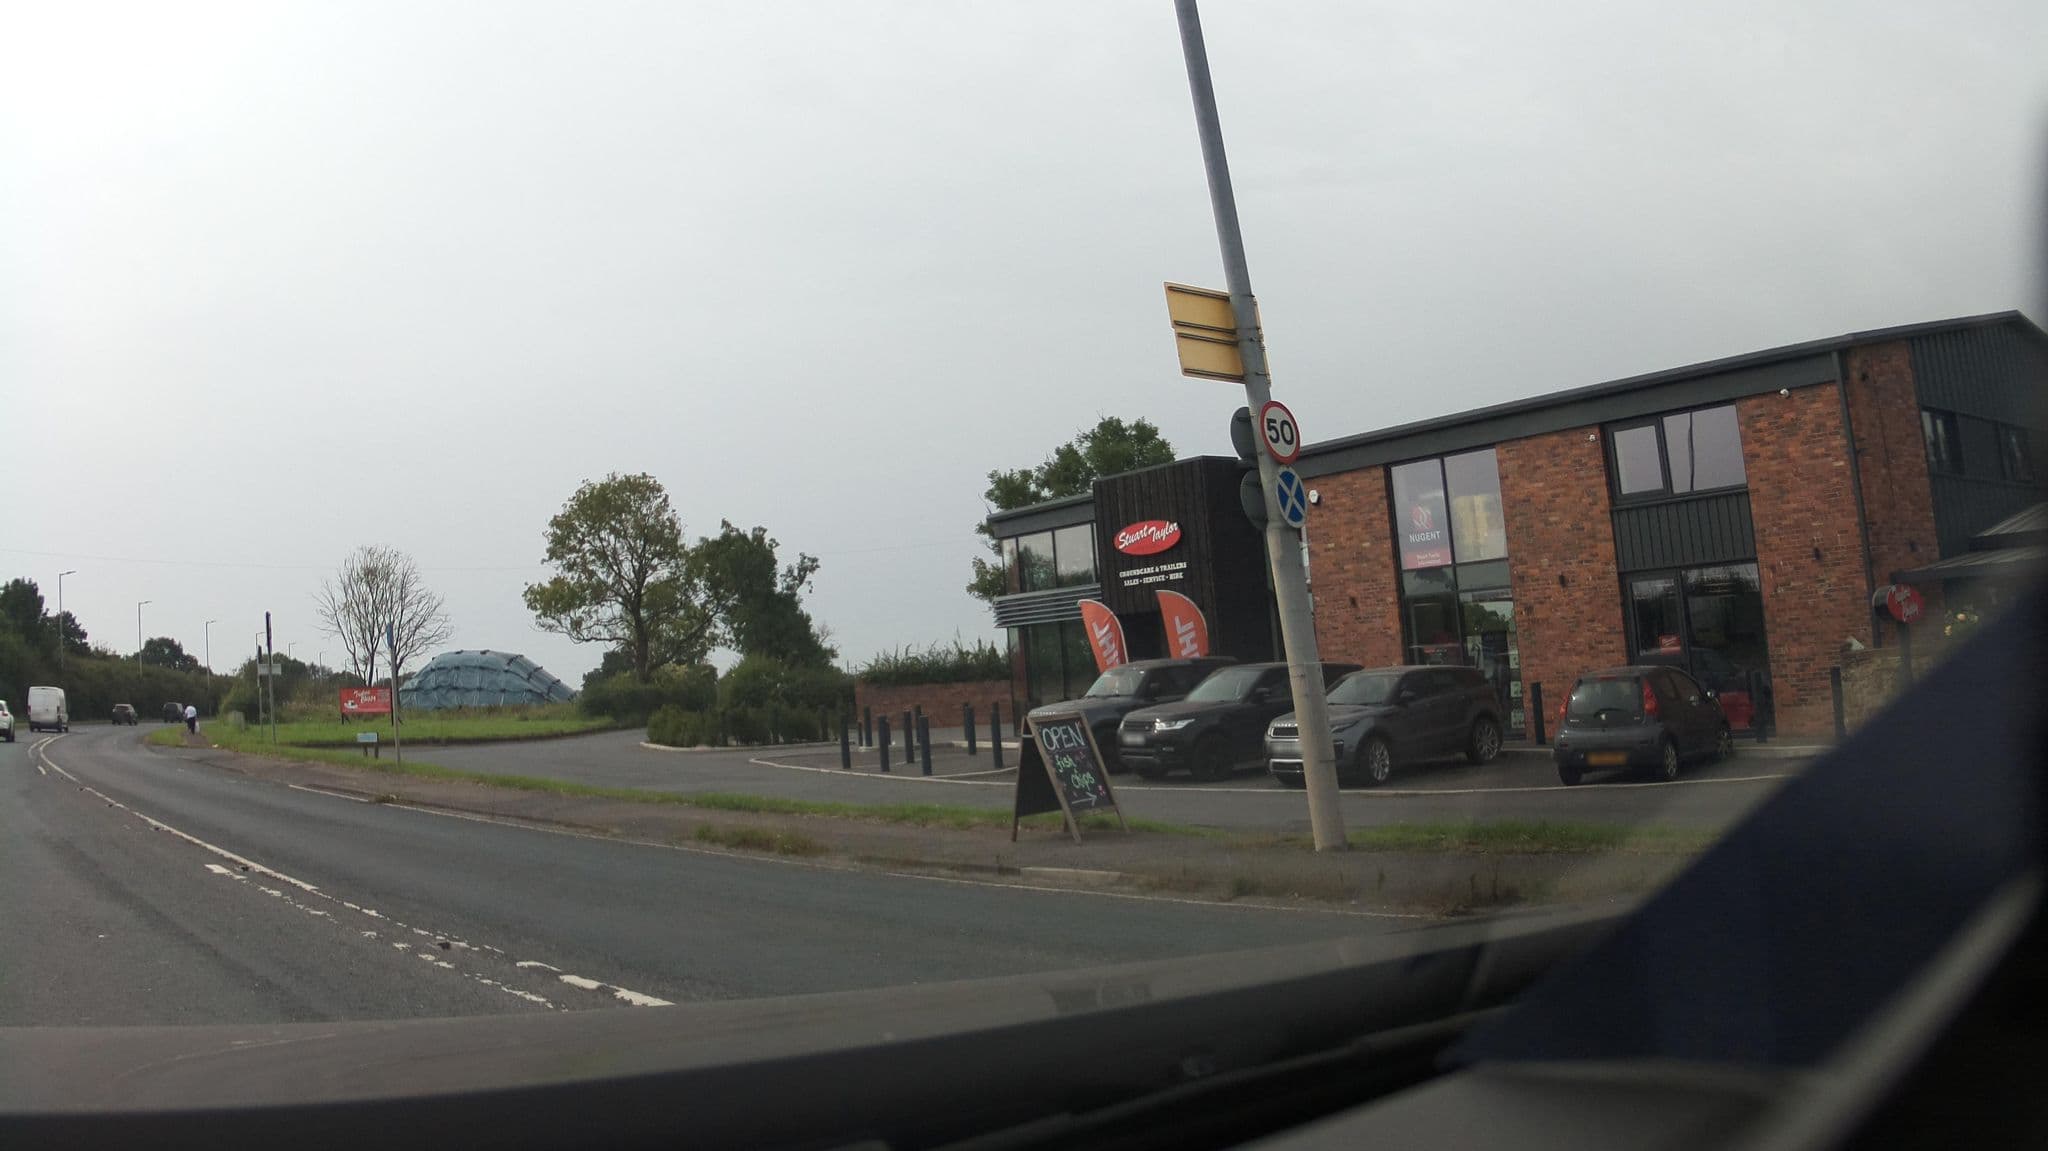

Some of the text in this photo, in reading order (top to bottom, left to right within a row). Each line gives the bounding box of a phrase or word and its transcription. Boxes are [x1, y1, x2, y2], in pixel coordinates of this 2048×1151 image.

[1266, 418, 1294, 445] 50
[1119, 521, 1179, 549] Stuart Taylor
[1409, 531, 1441, 543] NUGENT
[1143, 574, 1166, 584] SERVICE
[1042, 721, 1085, 750] OPEN
